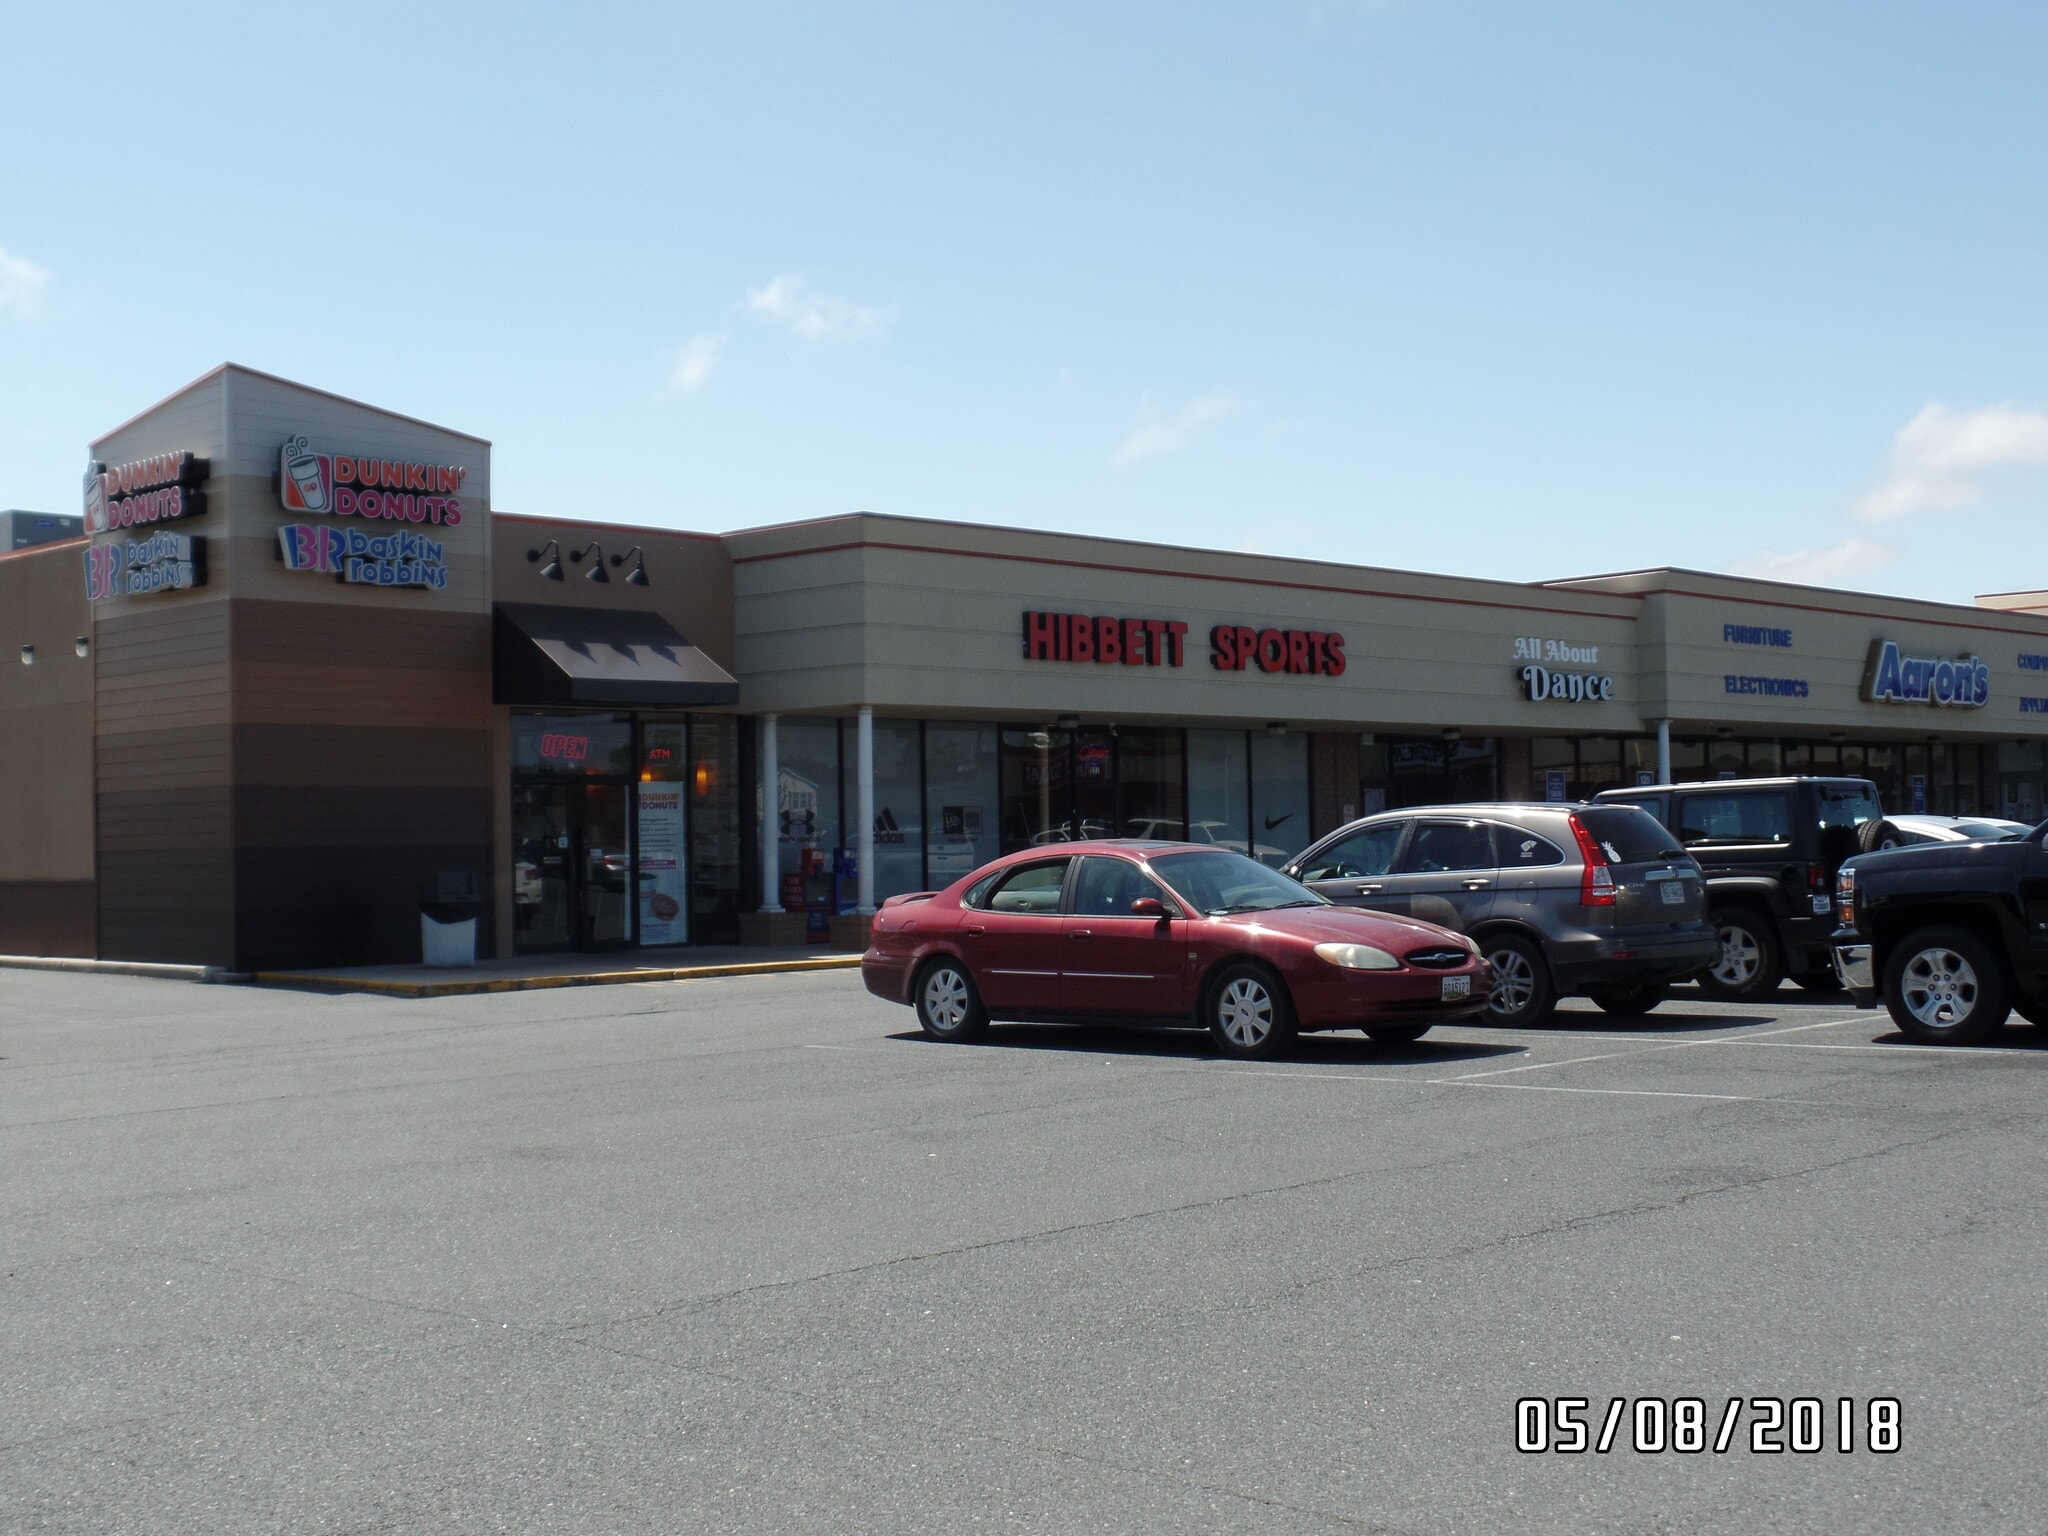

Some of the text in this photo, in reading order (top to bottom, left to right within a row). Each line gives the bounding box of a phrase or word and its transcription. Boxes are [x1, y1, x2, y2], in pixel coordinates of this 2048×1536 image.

[335, 455, 466, 492] DUNKIN'
[107, 486, 182, 529] DONUTS
[335, 487, 463, 525] DONUTS
[1024, 610, 1346, 676] HIBBETT SPORTS
[1513, 637, 1599, 663] All About
[1723, 624, 1792, 647] FURNITURE
[1522, 665, 1616, 703] Dance
[1724, 675, 1809, 697] ELECTRONICS
[1871, 639, 1990, 707] Aaron's
[540, 733, 588, 760] OPEN
[650, 748, 670, 760] ATM
[642, 802, 678, 810] DONUTS
